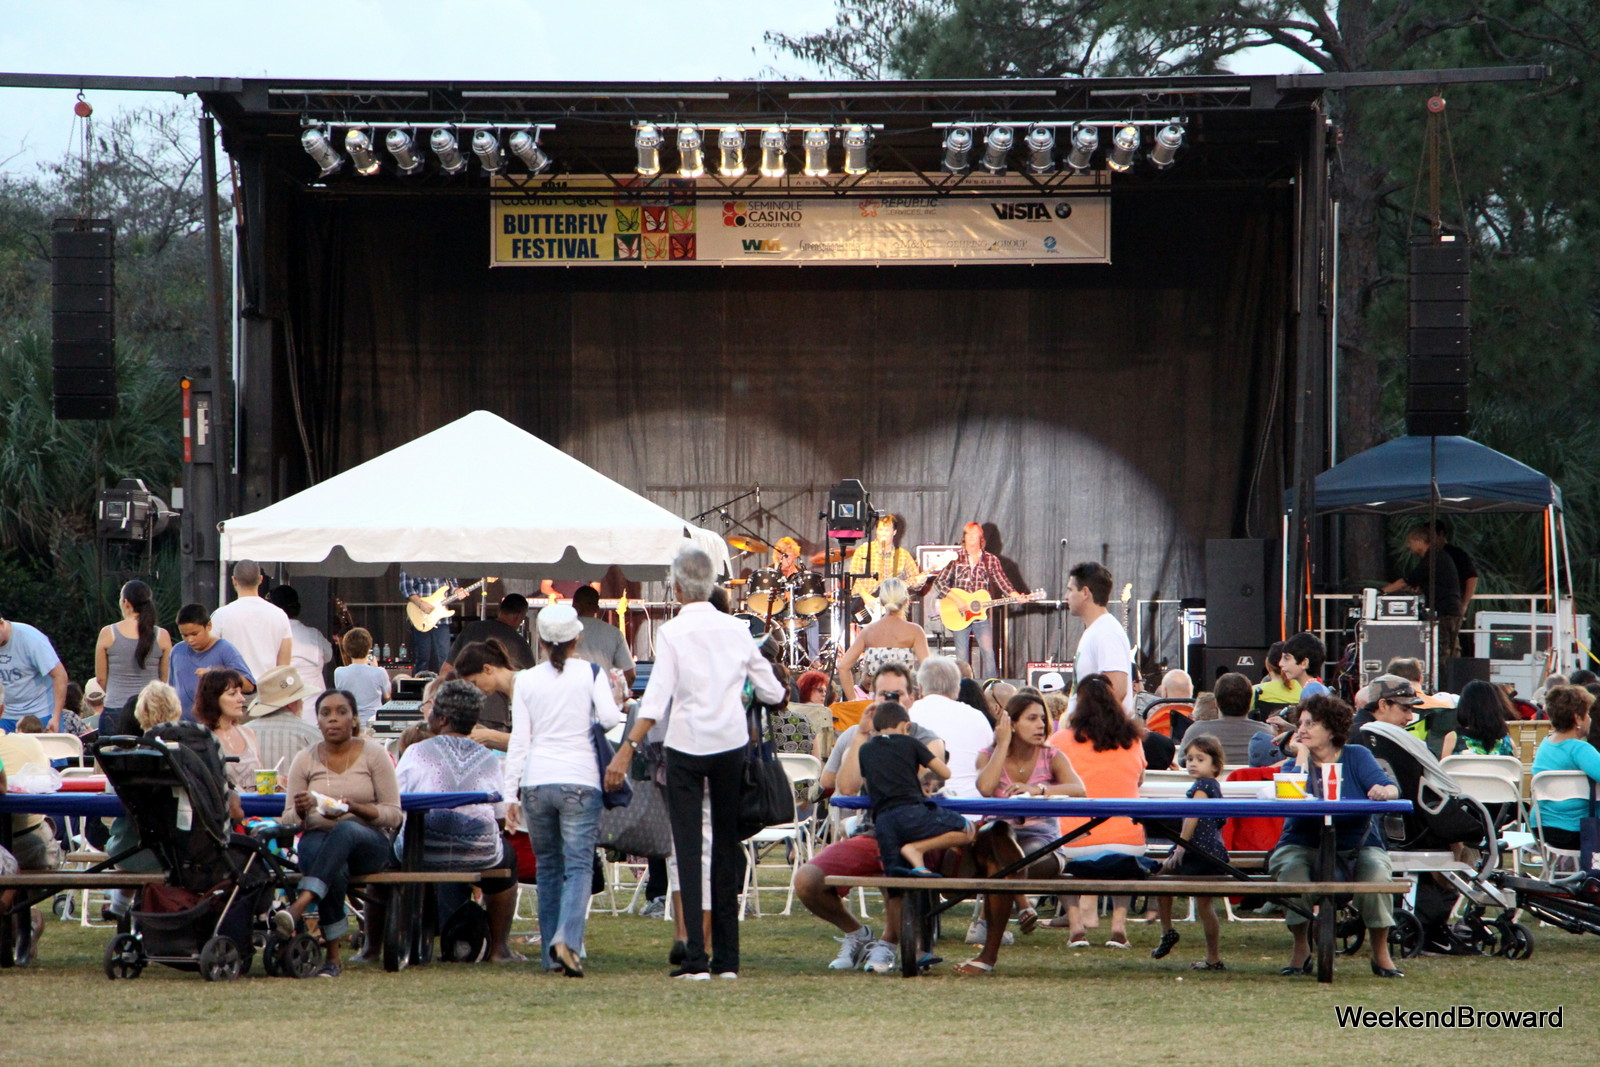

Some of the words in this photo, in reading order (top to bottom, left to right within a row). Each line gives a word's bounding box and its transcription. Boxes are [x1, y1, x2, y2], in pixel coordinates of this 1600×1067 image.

[749, 201, 802, 211] SEMINOLE
[881, 199, 938, 208] REPUBLIC
[748, 211, 802, 222] CASINO
[991, 203, 1052, 220] VISTA
[503, 214, 608, 234] BUTTERFLY
[512, 238, 599, 259] FESTIVAL
[742, 240, 781, 251] WM
